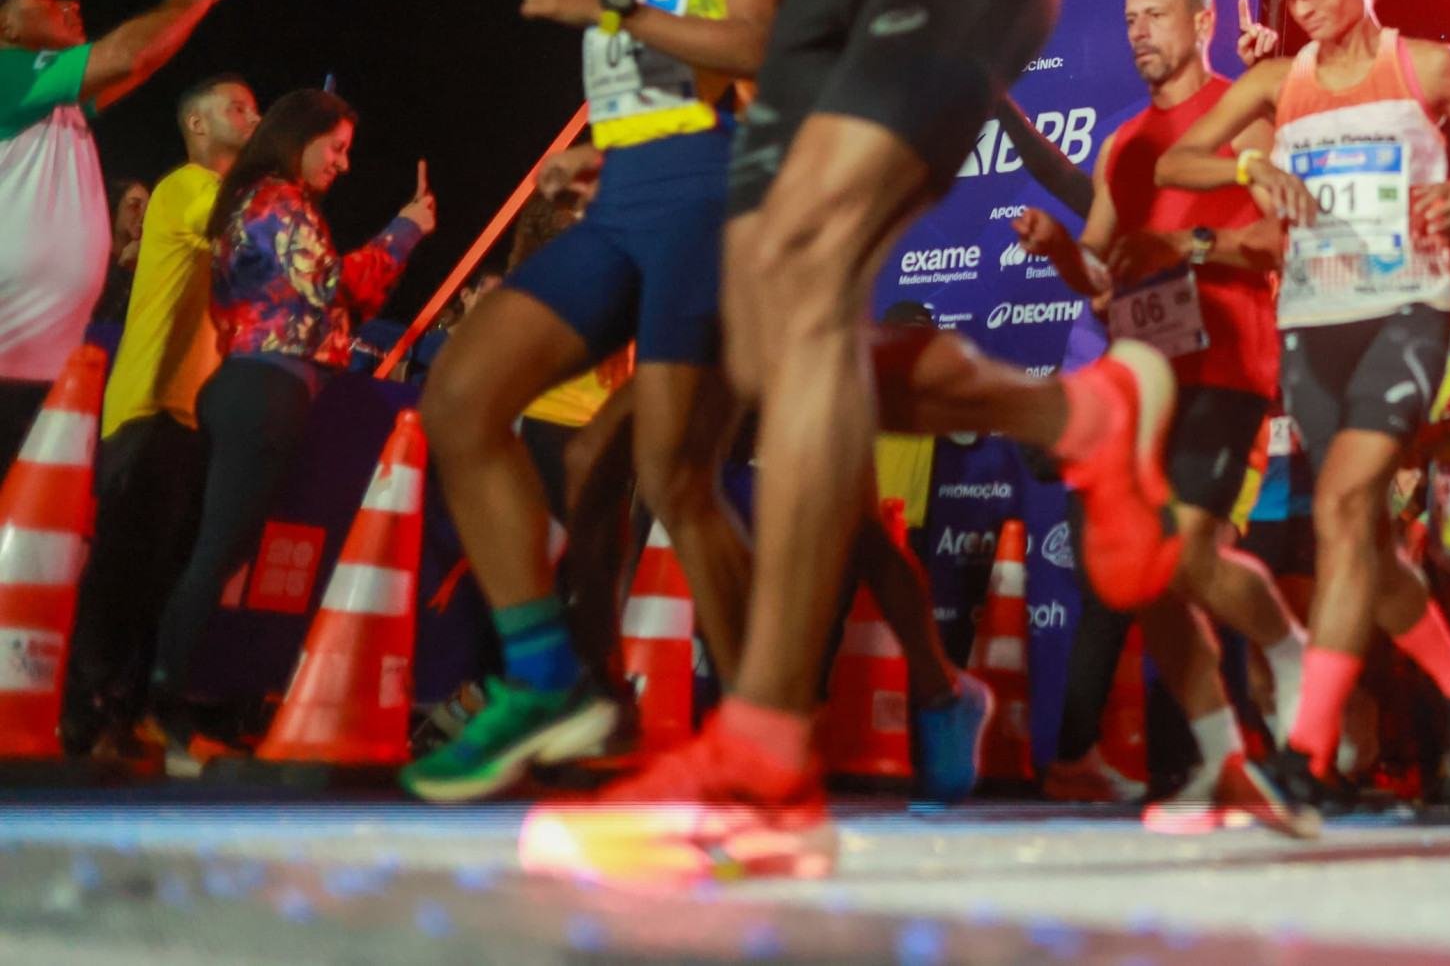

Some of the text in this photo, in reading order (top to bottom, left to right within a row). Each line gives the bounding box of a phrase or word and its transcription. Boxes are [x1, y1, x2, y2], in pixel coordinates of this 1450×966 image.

[1319, 182, 1357, 215] 01
[901, 245, 981, 273] exame
[899, 271, 978, 285] Medicina Diagnóstica
[1131, 293, 1166, 329] 06
